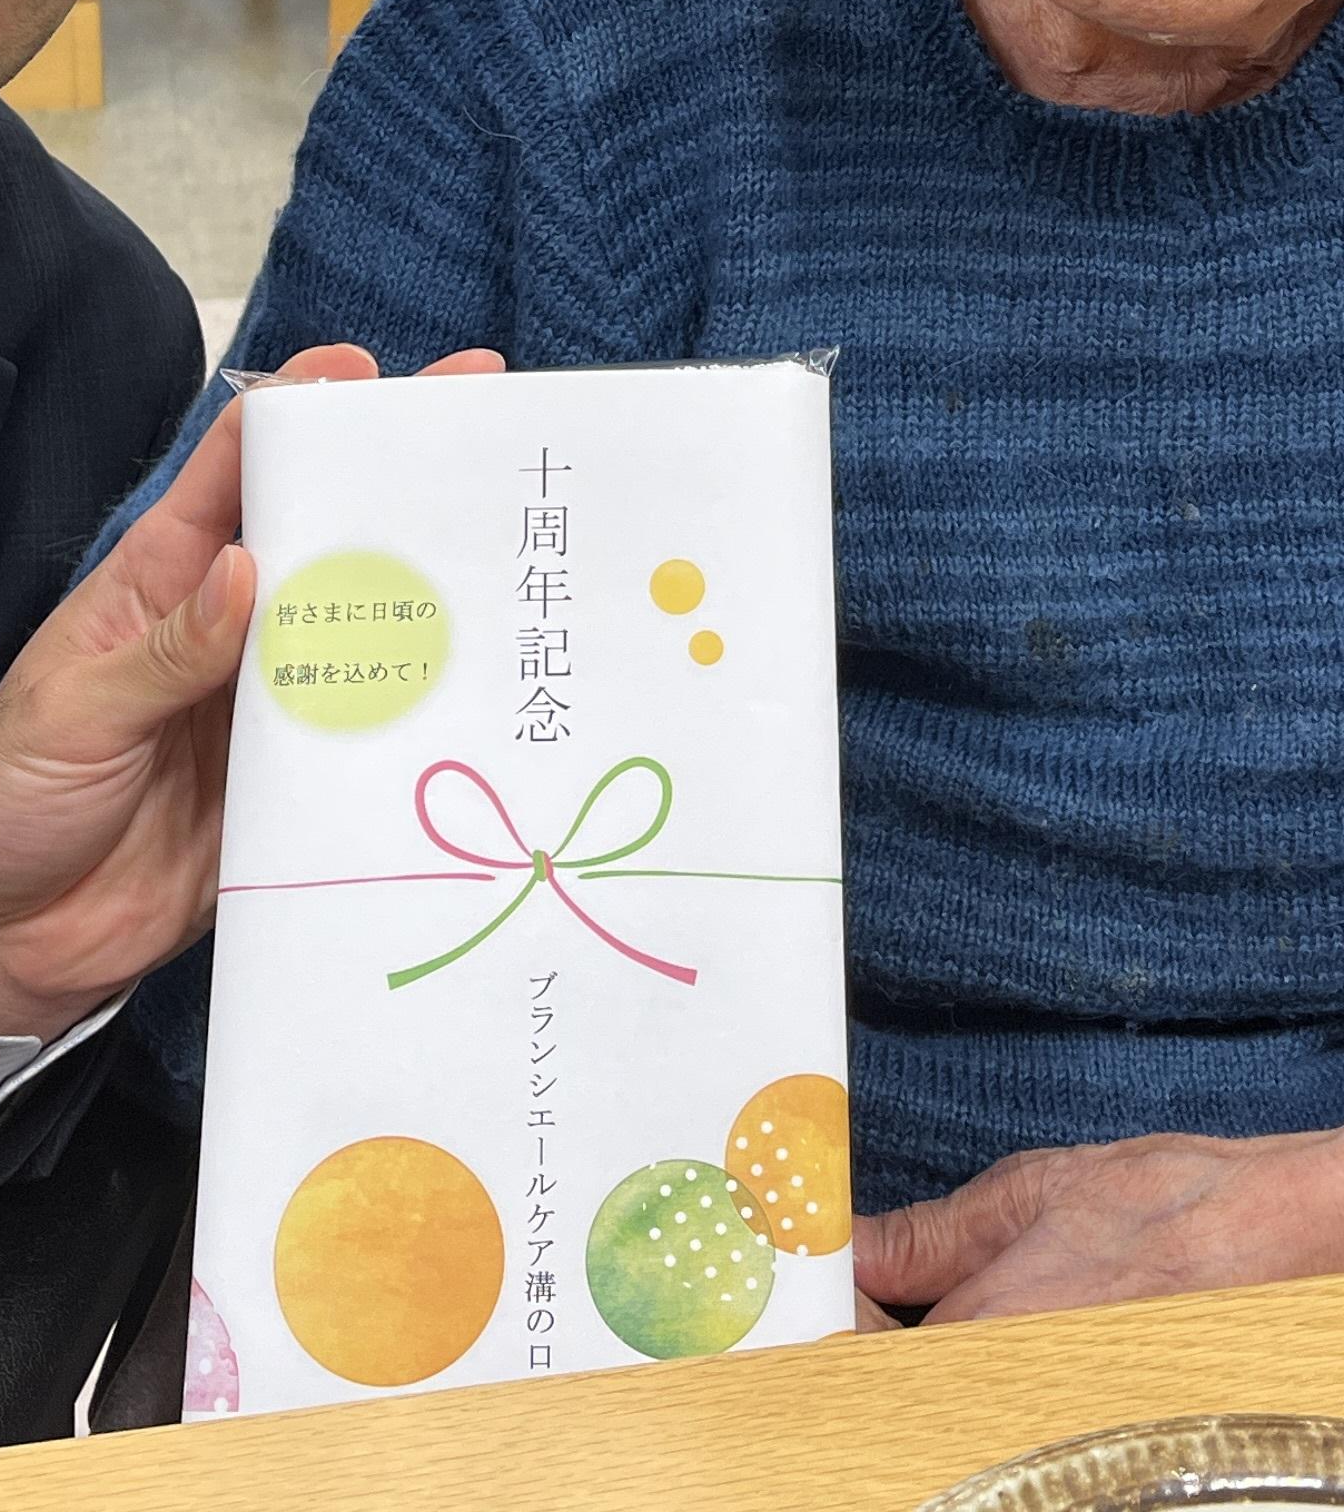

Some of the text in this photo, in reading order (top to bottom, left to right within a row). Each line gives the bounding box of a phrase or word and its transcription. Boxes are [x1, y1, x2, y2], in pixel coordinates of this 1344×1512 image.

[273, 662, 429, 687] 感謝を込めて！
[276, 600, 438, 627] 皆さまに日頃の
[514, 447, 573, 744] 十周年記念
[524, 971, 560, 1370] ブランシエールケア溝の口
